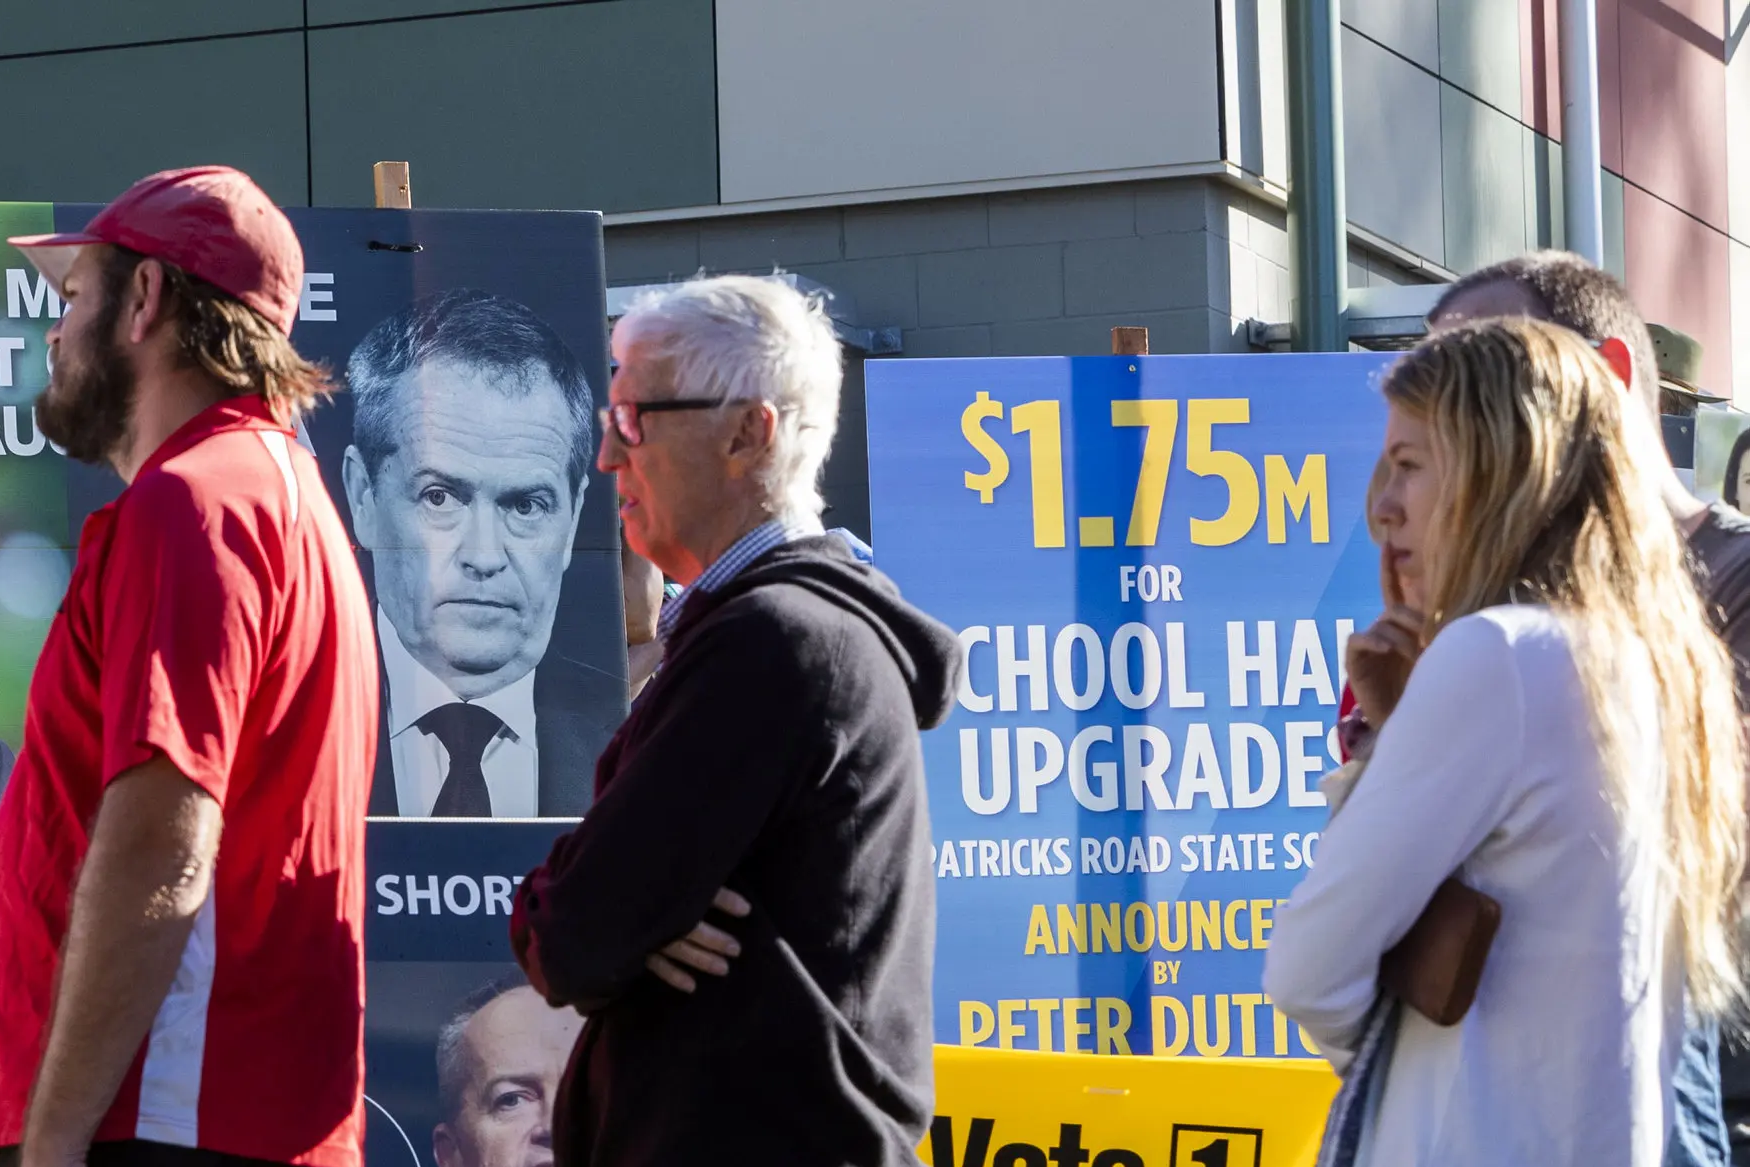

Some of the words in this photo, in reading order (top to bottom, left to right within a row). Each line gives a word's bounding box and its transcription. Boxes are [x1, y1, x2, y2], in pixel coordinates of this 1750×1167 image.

[960, 390, 1331, 549] $1.75M
[1119, 564, 1184, 603] FOR
[1080, 835, 1171, 876] ROAD
[1180, 832, 1276, 873] STATE
[1023, 899, 1290, 956] ANNOUNCE
[1153, 960, 1182, 986] BY
[959, 997, 1134, 1055] PETER
